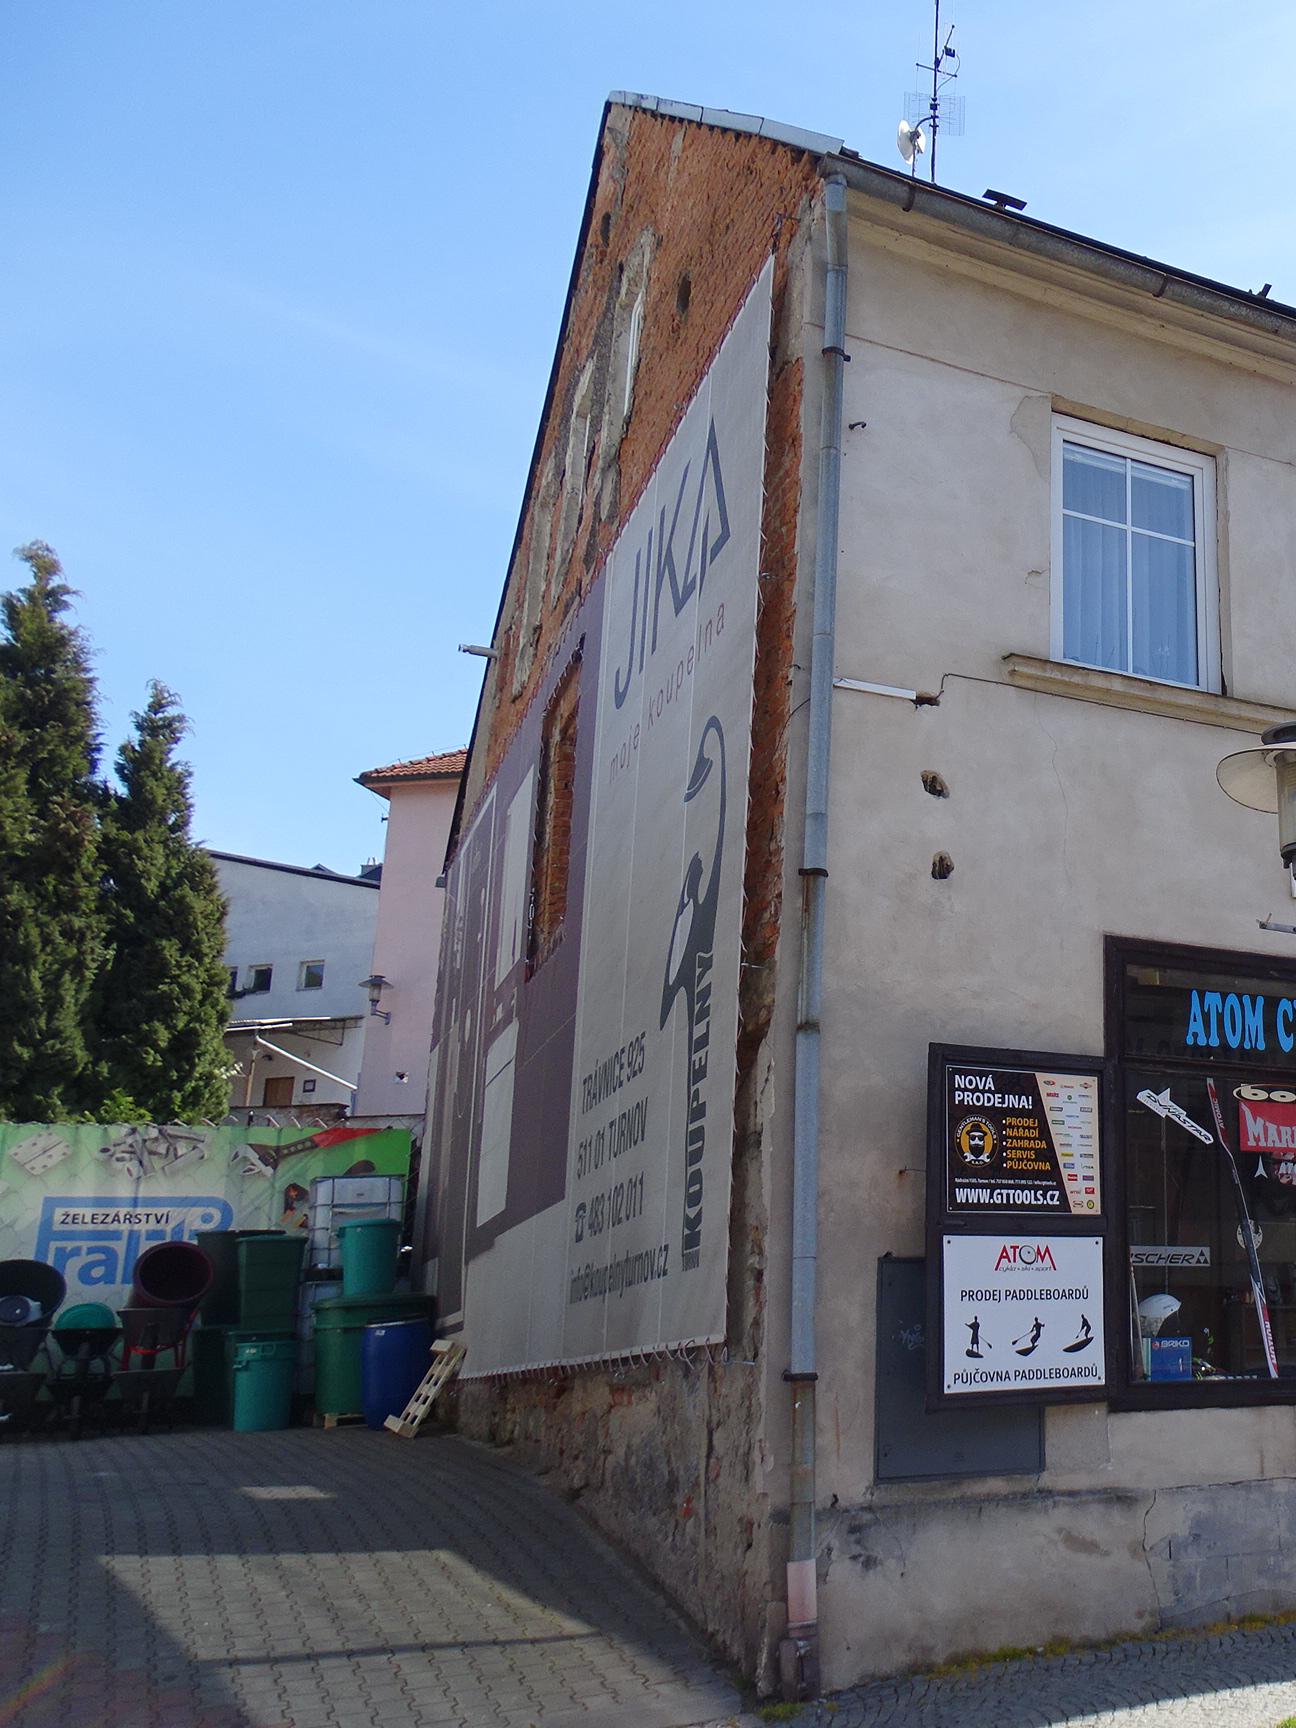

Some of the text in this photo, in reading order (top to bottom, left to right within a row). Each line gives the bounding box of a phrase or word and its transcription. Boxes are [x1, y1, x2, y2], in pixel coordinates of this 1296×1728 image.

[616, 414, 731, 710] JIKA
[609, 602, 726, 785] moje koupelna
[1186, 989, 1266, 1051] ATOM
[582, 1031, 647, 1115] TRÁVNICE 925
[954, 1074, 996, 1091] NOVÁ
[684, 951, 713, 1253] KOUPELNY
[954, 1091, 1034, 1110] PRODEJNA!
[608, 1096, 649, 1161] TURNOV
[1006, 1117, 1038, 1128] PRODEJ
[1006, 1127, 1040, 1138] NÁŘADÍ
[1006, 1138, 1048, 1149] ZAHRADA
[1006, 1149, 1036, 1159] SERVIS
[1006, 1160, 1052, 1171] PŮJČOVNA
[607, 1183, 625, 1230] 102
[626, 1170, 645, 1220] 011
[954, 1187, 1061, 1206] WWW.GTTOOLS.CZ
[59, 1210, 172, 1226] ŽELEZÁŘSTVÍ
[994, 1243, 1057, 1272] ATOM
[960, 1285, 1089, 1304] PRODEJ PADDLEBOARDŮ
[1160, 1339, 1190, 1349] BRIKO
[953, 1363, 1099, 1385] PŮJČOVNA PADDLEBOARDŮ
